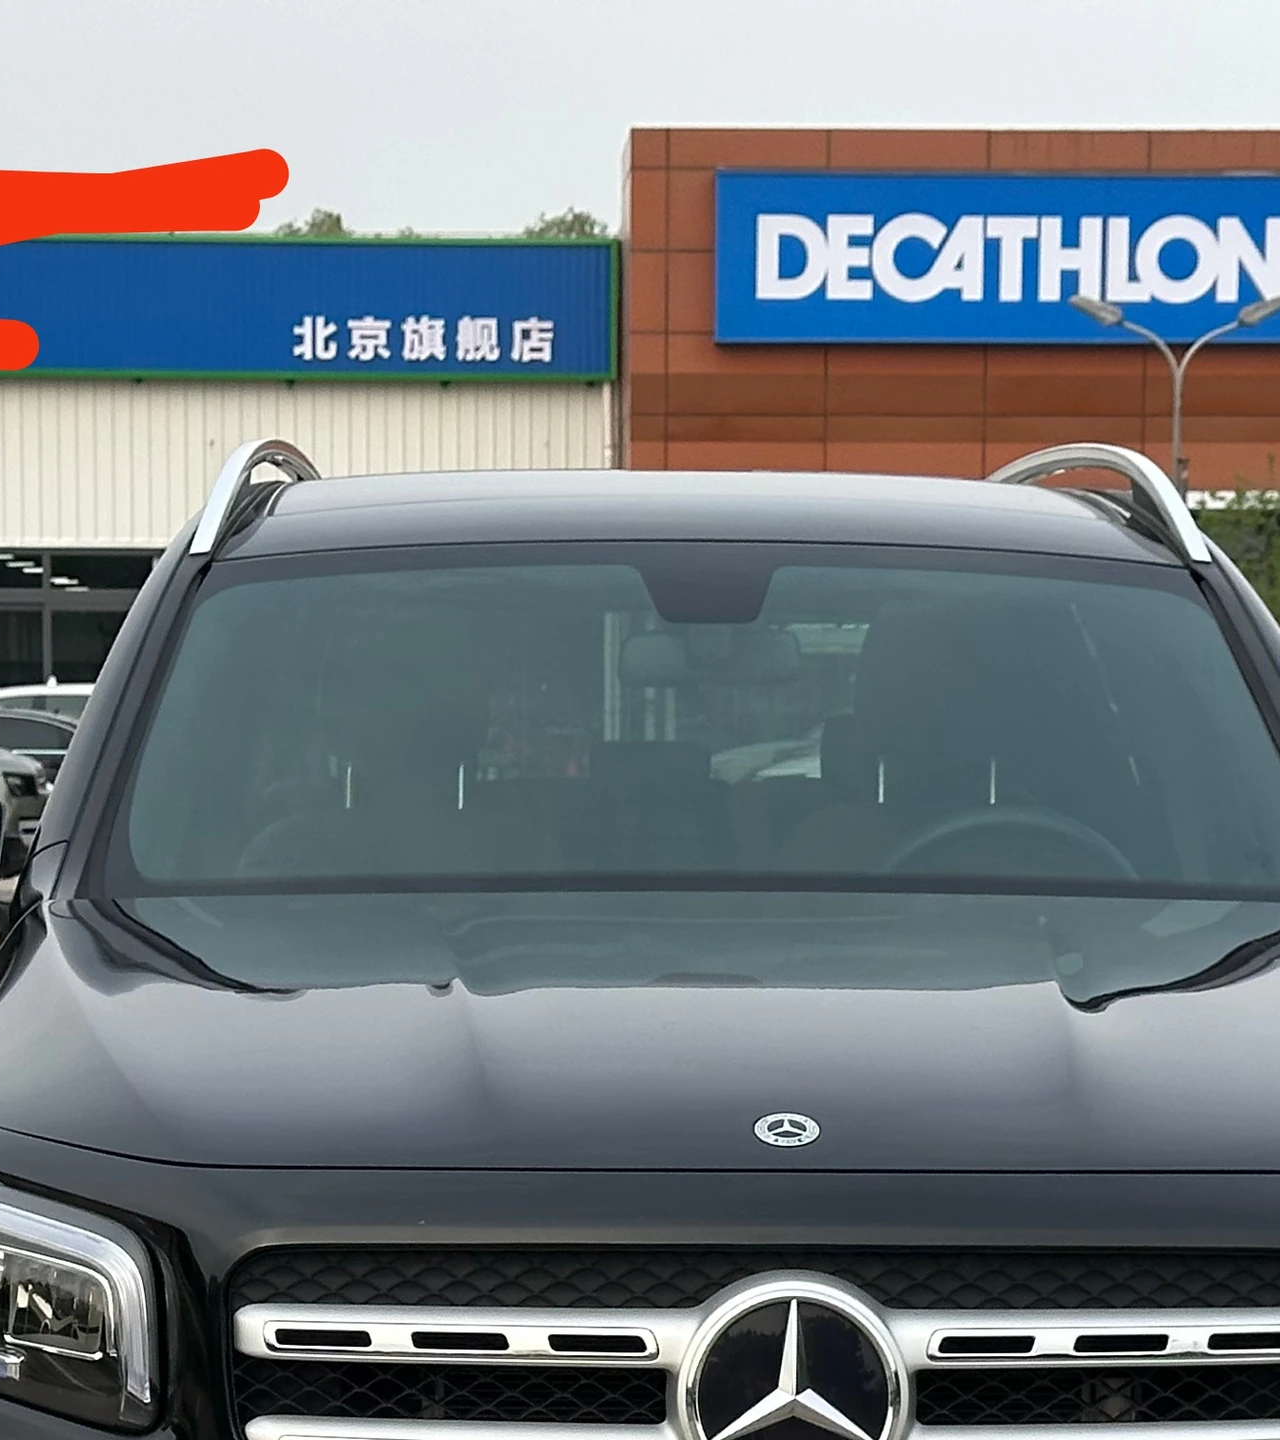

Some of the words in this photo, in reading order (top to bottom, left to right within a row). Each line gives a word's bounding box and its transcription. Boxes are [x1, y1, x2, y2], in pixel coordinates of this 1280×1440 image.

[292, 315, 555, 363] 北京旗舰店
